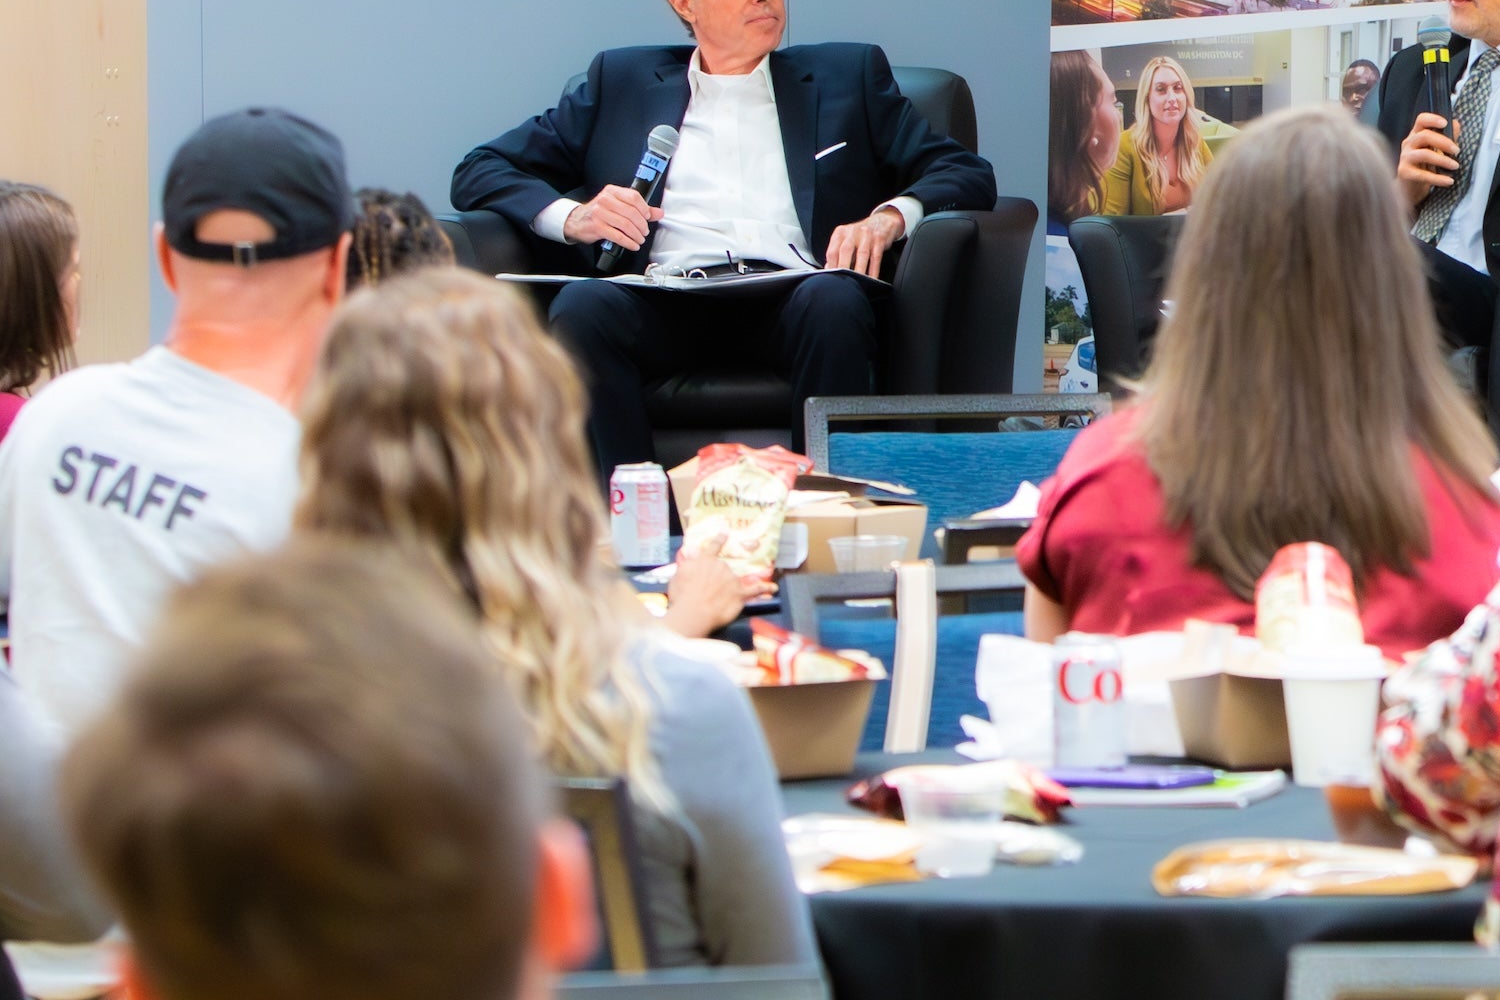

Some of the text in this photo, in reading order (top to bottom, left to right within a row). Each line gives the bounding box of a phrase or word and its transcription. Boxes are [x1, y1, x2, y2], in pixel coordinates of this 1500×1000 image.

[1177, 50, 1244, 60] WASHINGTON DC
[52, 446, 208, 530] STAFF
